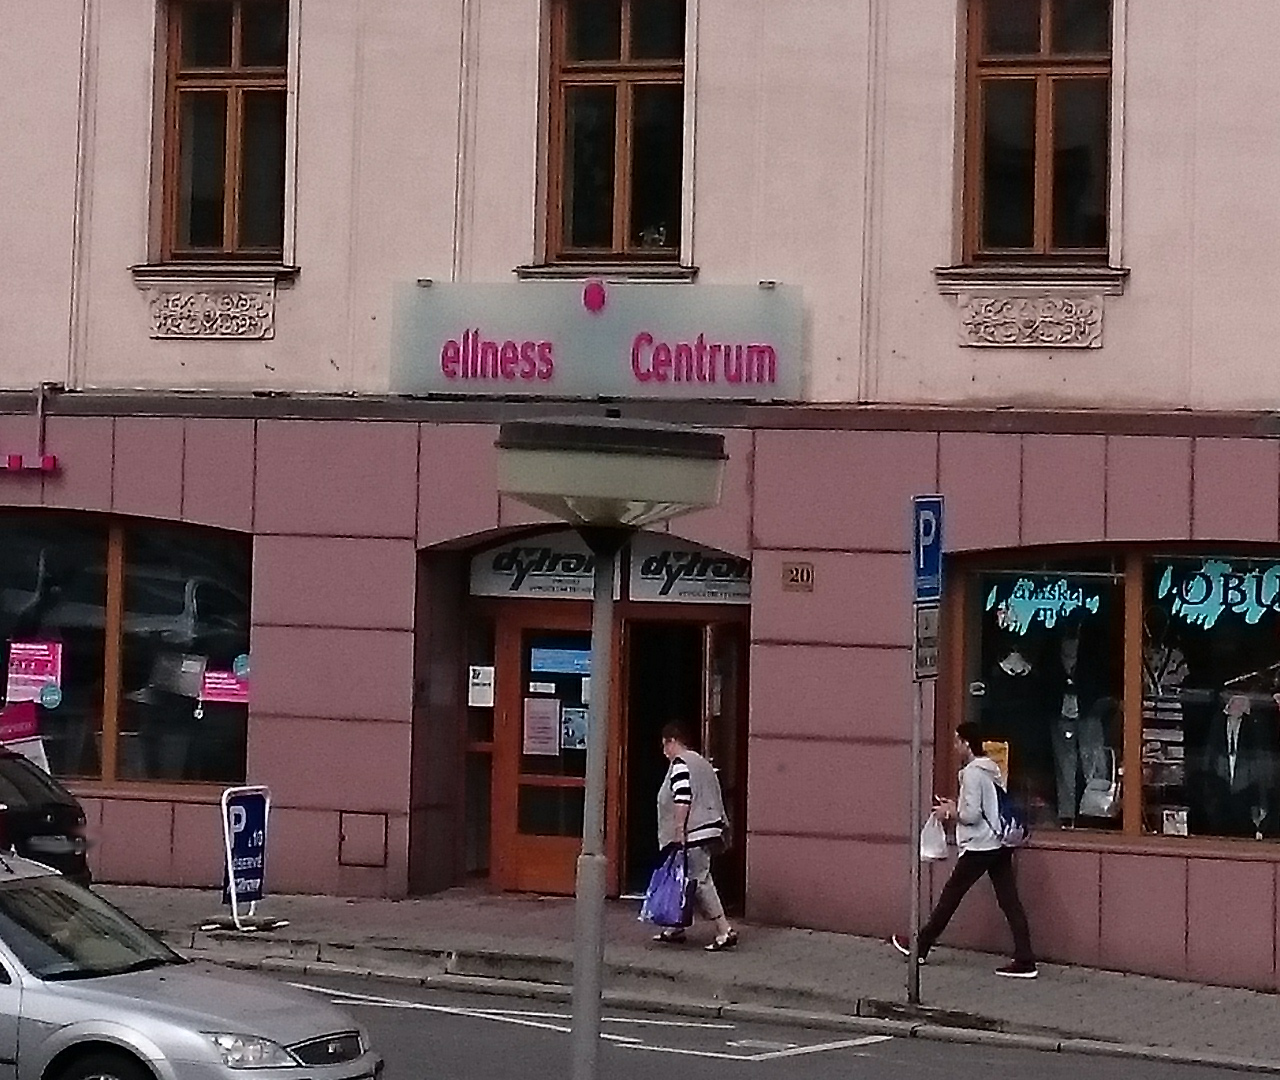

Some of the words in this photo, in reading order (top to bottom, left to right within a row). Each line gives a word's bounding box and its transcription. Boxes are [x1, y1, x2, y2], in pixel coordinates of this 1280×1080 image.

[631, 332, 777, 384] Centrum
[920, 510, 937, 569] P
[788, 567, 811, 584] 20
[229, 805, 247, 850] P
